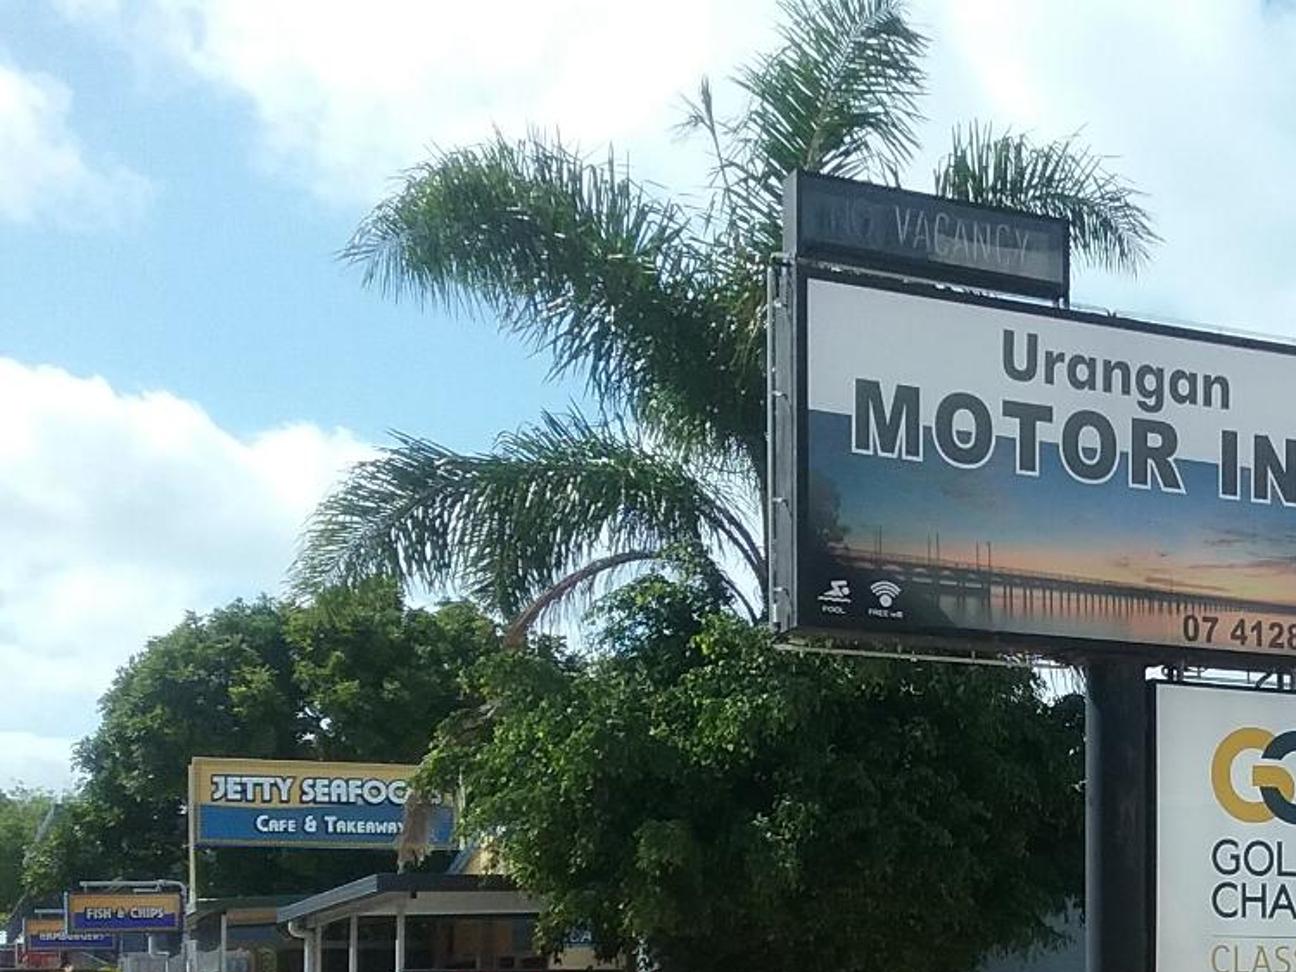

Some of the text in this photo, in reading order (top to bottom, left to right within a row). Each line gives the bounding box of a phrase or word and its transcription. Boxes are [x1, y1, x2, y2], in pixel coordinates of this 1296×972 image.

[894, 205, 1029, 265] VACANCY
[1003, 329, 1230, 412] Urangan
[851, 376, 1186, 495] MOTOR
[821, 605, 846, 615] POOL
[1183, 614, 1218, 643] 07
[211, 774, 296, 802] JETTY
[303, 814, 317, 833] &
[86, 907, 112, 919] FISH
[130, 906, 165, 919] CHIPS
